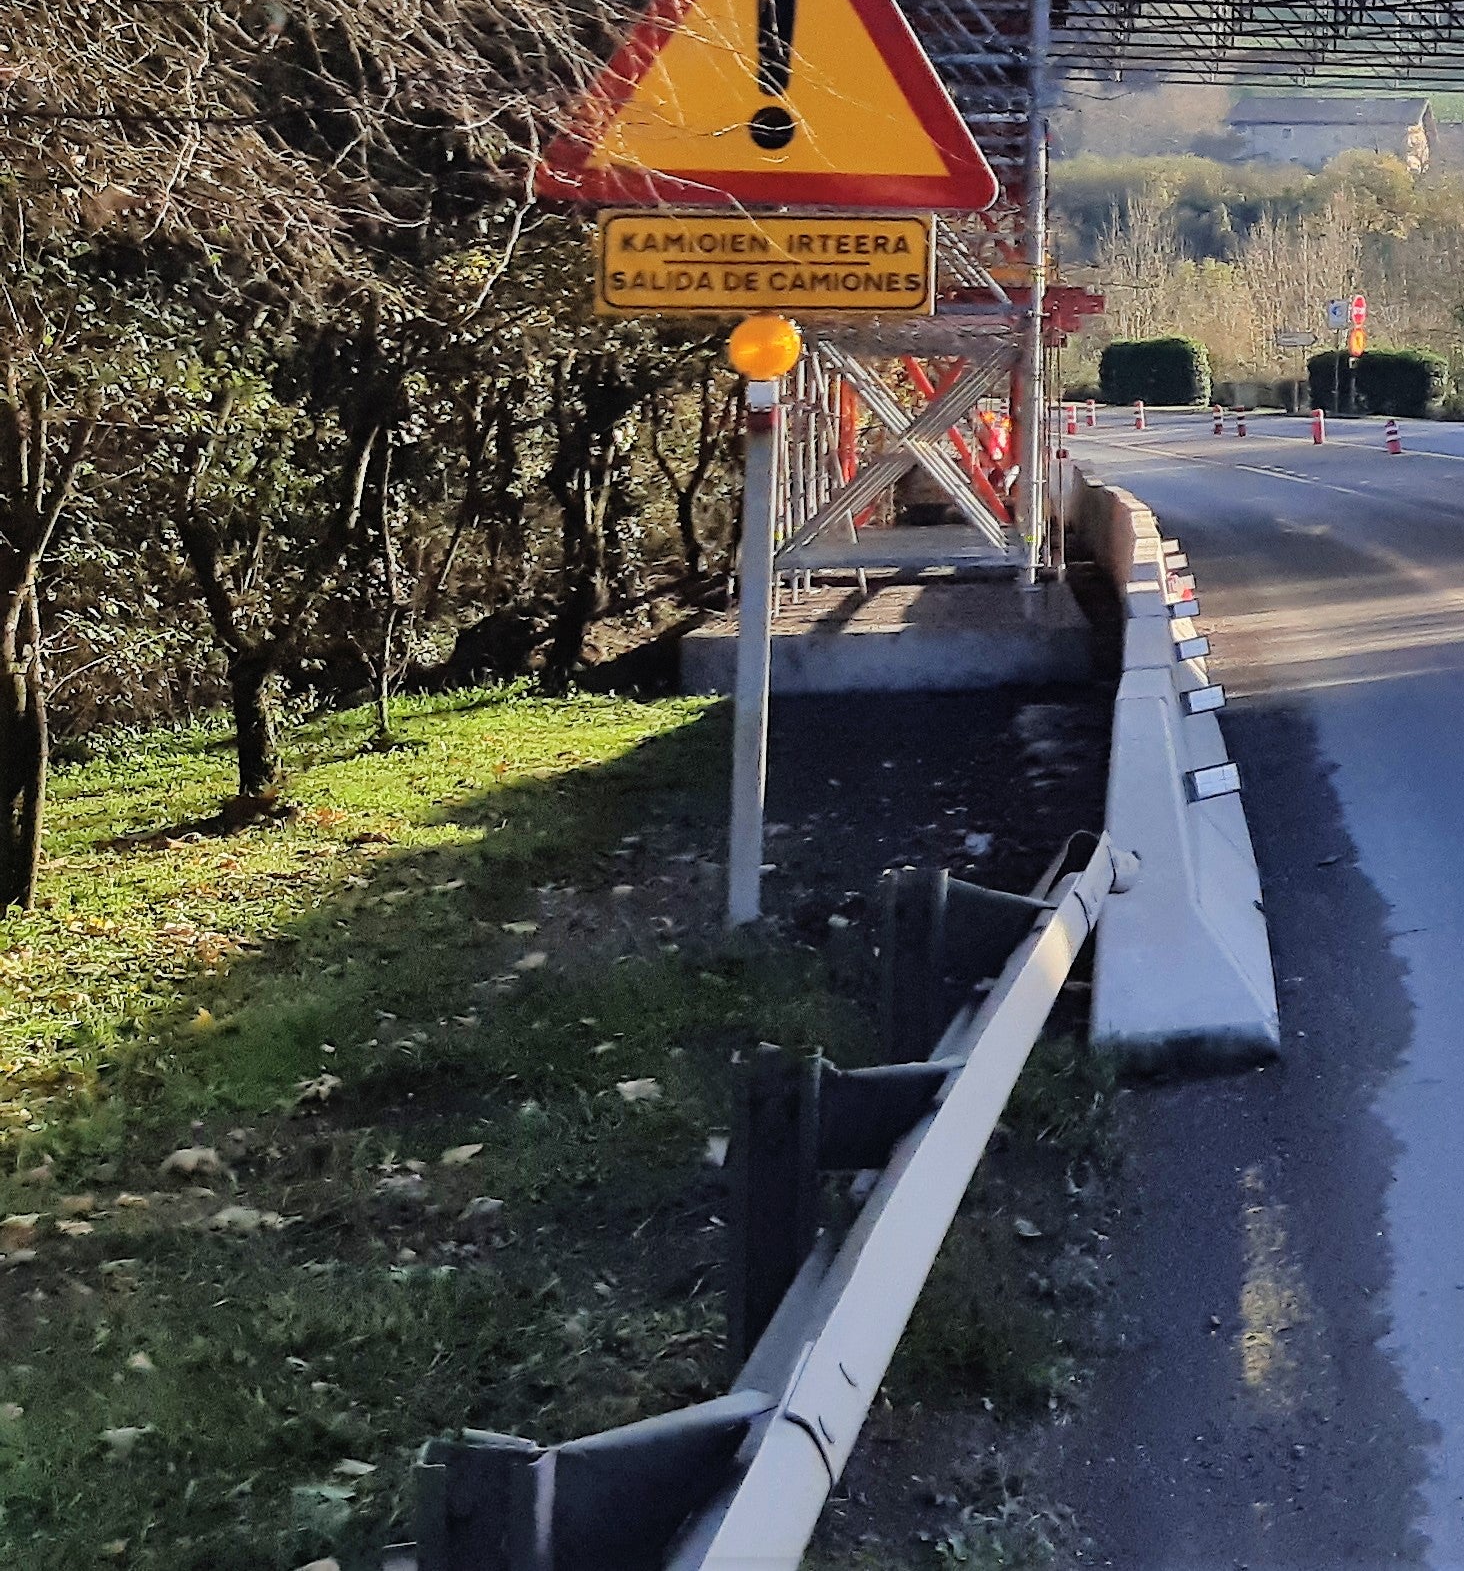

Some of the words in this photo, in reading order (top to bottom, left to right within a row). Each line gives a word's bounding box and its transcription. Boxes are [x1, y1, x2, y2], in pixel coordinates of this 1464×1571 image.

[621, 232, 769, 254] KAMIOIEN
[789, 233, 911, 255] IRTEERA
[610, 271, 713, 292] SALIDA
[723, 271, 758, 292] DE
[769, 272, 922, 292] CAMIONES
